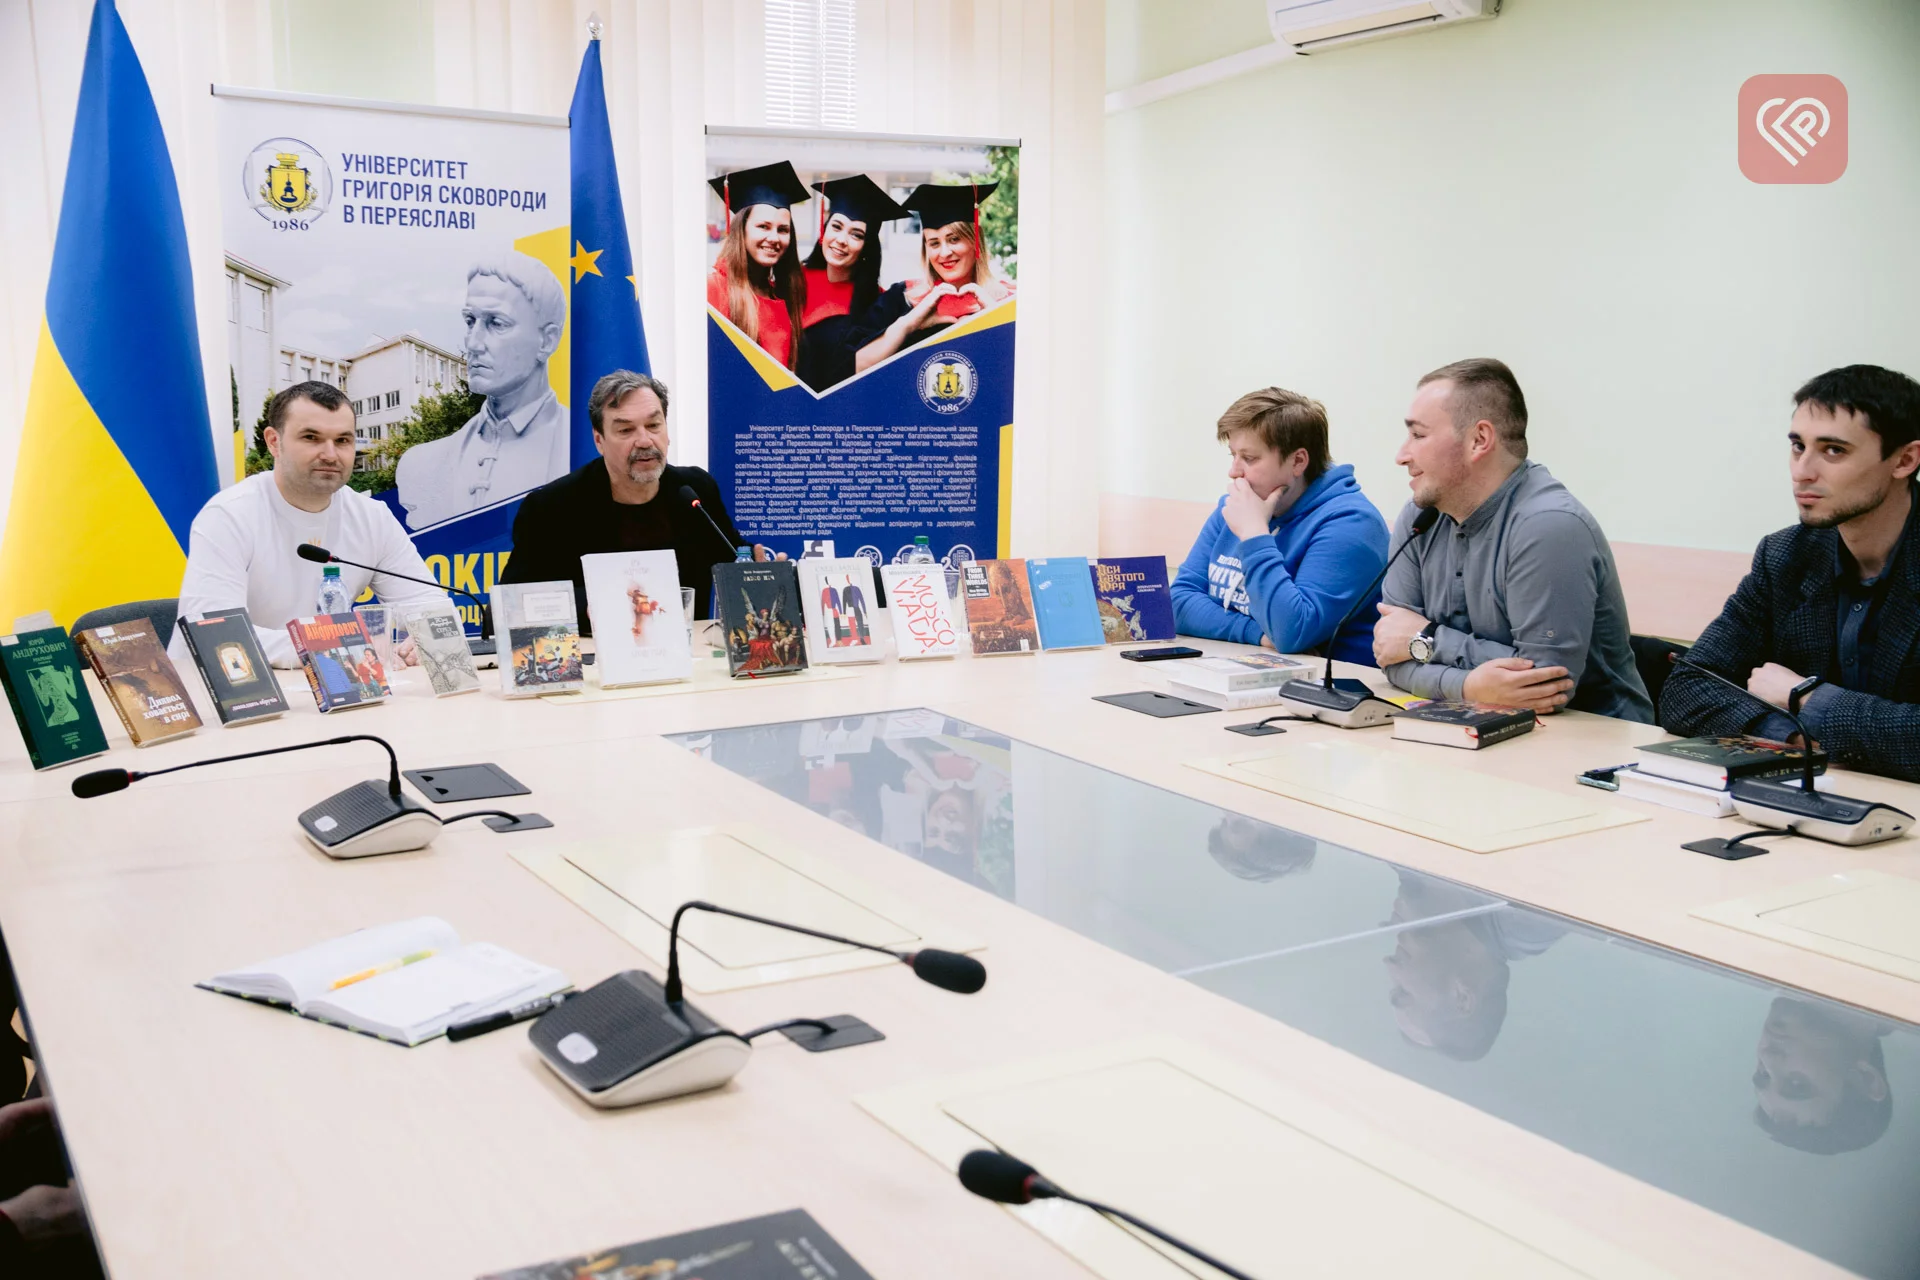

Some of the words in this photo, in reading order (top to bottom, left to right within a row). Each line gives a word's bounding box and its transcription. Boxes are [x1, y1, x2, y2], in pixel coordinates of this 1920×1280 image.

[341, 152, 468, 180] УНІВЕРСИТЕТ
[342, 179, 432, 203] ГРИГОРІЯ
[438, 185, 547, 212] СКОВОРОДИ
[271, 218, 310, 232] 1986
[343, 204, 355, 223] В
[361, 205, 476, 230] ПЕРЕЯСЛАВІ
[937, 403, 959, 413] 1986
[738, 528, 758, 536] ідкриті
[424, 551, 512, 597] ОКІ
[12, 641, 67, 659] АНДРУХОВИЧ
[148, 693, 182, 709] Диявол
